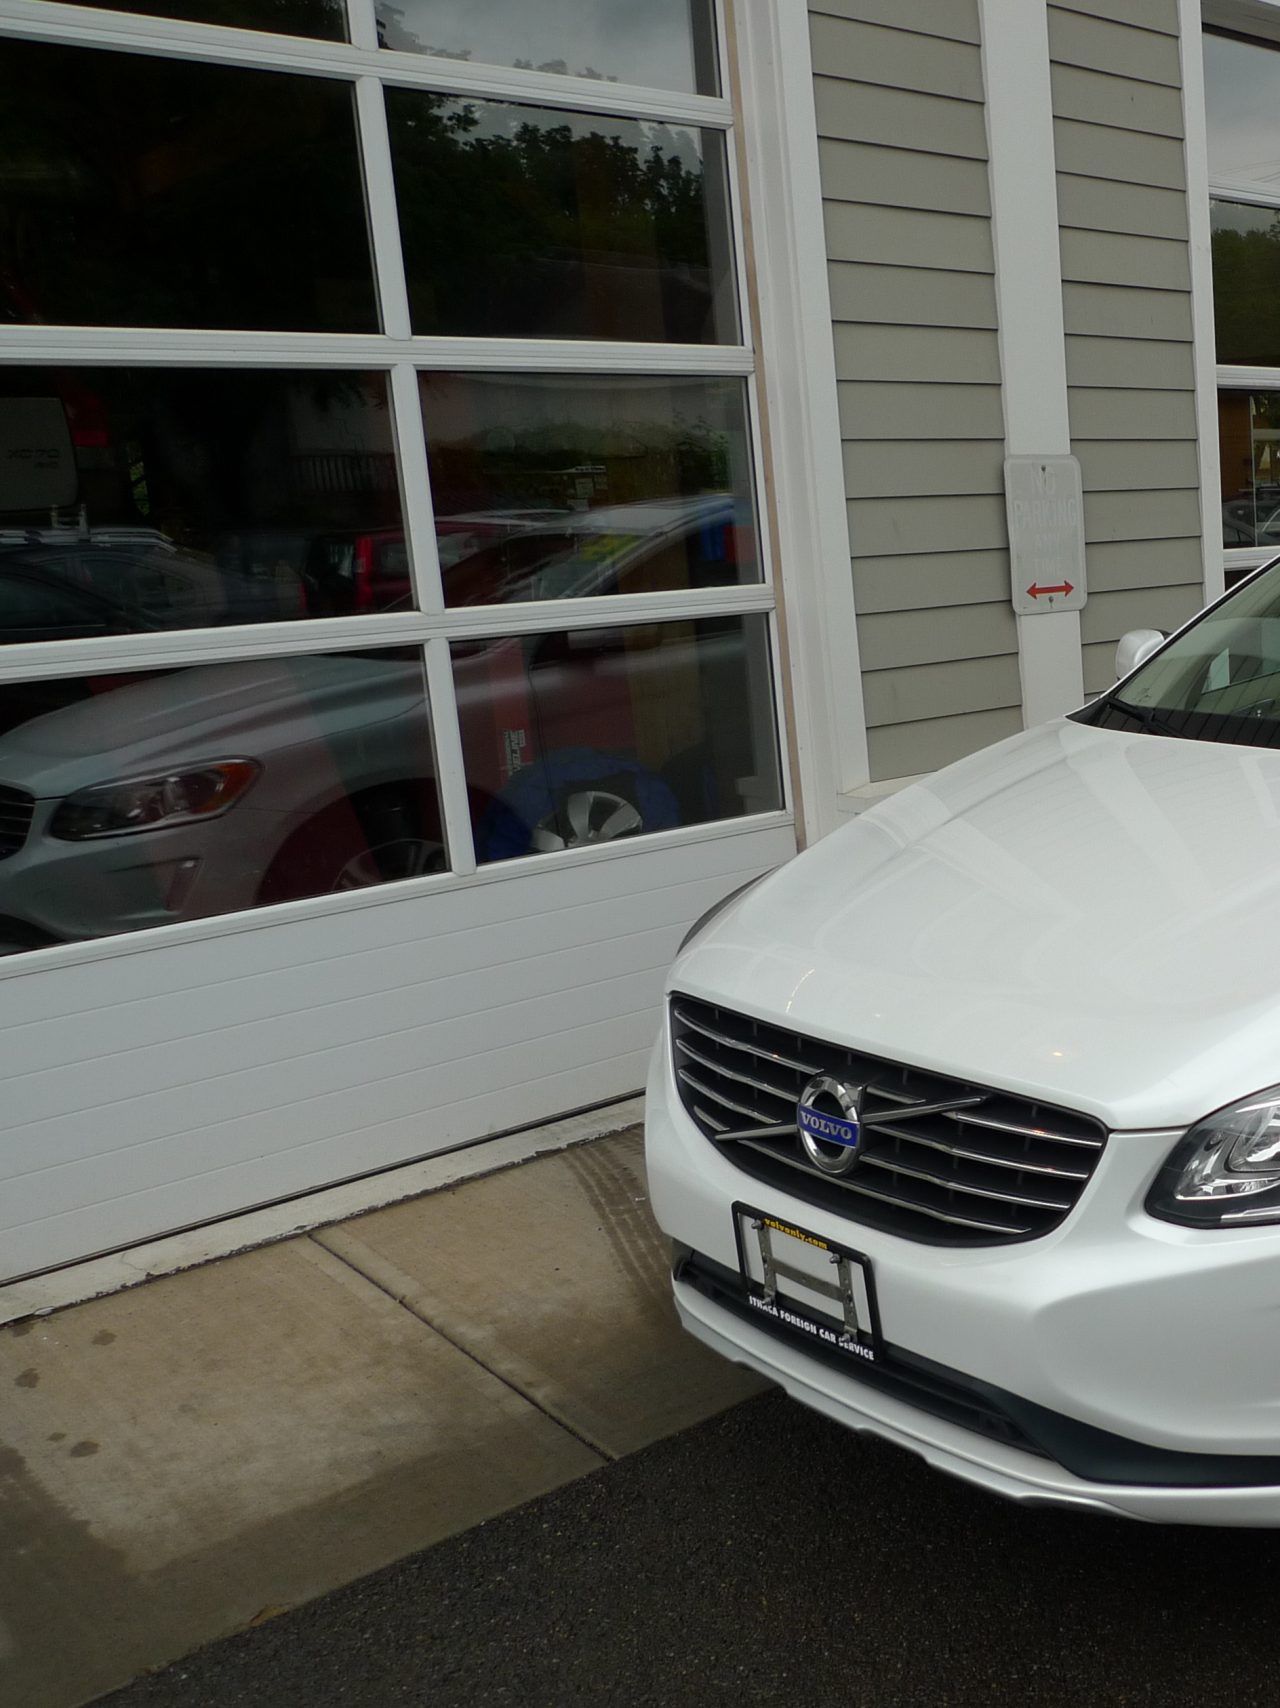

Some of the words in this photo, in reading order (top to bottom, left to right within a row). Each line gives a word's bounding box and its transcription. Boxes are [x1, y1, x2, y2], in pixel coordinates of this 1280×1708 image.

[1031, 466, 1056, 495] NO
[1015, 497, 1077, 528] PARKING
[801, 1111, 852, 1140] VOLVO
[749, 1295, 779, 1317] ITHACA
[780, 1310, 817, 1334] FOREIGN
[819, 1328, 837, 1344] CAR
[838, 1337, 875, 1361] SERVICE
